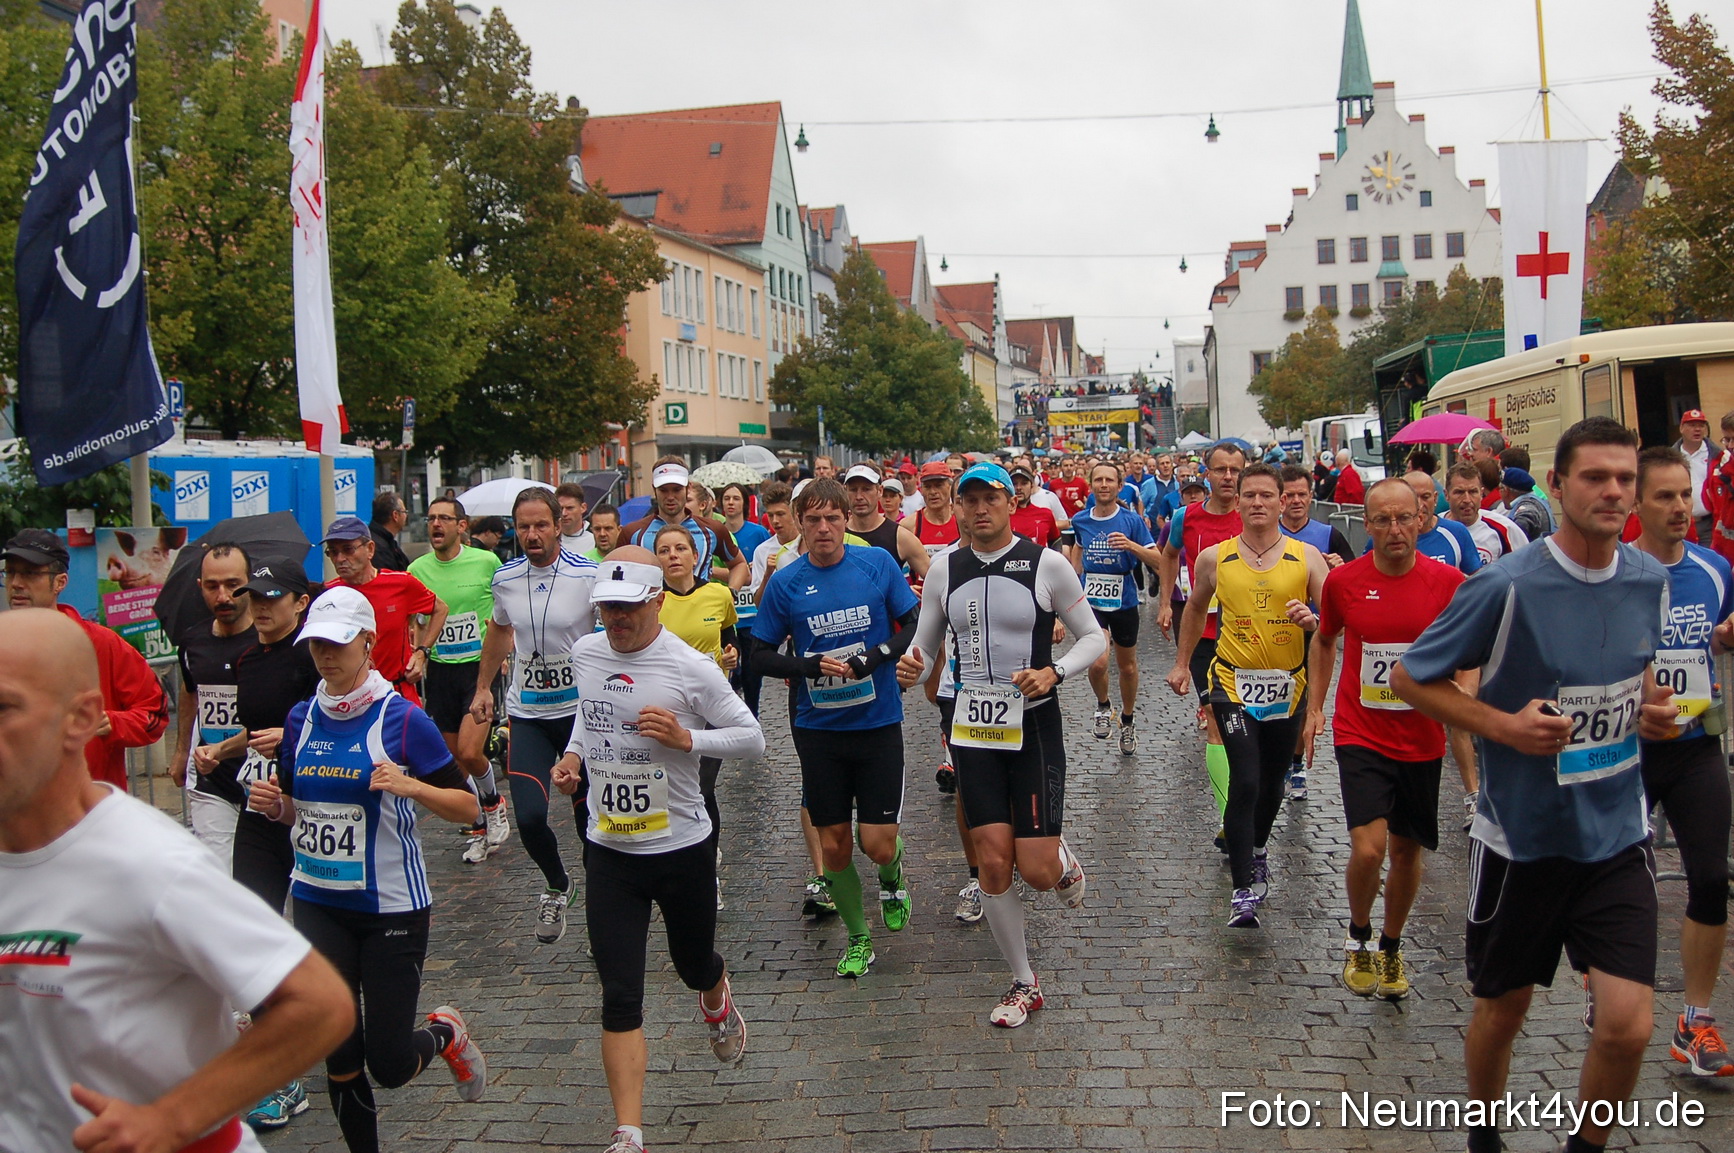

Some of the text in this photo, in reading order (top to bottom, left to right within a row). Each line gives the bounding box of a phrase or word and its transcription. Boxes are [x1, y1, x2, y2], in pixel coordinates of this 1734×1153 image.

[170, 386, 180, 413] P
[1506, 386, 1556, 415] Bayerisches
[668, 405, 685, 421] D
[1078, 414, 1109, 422] START
[1506, 416, 1530, 436] Rotes
[334, 473, 356, 491] IXI
[1087, 583, 1119, 597] 2256
[108, 602, 131, 614] BEIDE
[129, 607, 152, 619] GRÜN
[807, 605, 871, 629] HUBER
[439, 623, 476, 642] 2972
[823, 620, 868, 633] TECHNOLOGY
[968, 600, 981, 668] TSG 08 Roth
[1660, 621, 1713, 647] RNER
[1660, 657, 1696, 665] Neumarkt
[524, 666, 574, 689] 2988
[602, 684, 634, 694] skinfit
[822, 687, 861, 700] Christoph
[1241, 682, 1289, 704] 2254
[535, 694, 565, 703] Johann
[1560, 695, 1597, 706] PARTL
[968, 699, 1008, 724] 502
[1571, 698, 1635, 745] 2672
[969, 728, 1004, 740] Christof
[308, 740, 335, 751] HEITEC
[296, 765, 362, 780] LAC QUELLE
[591, 767, 651, 780] PARTL Neumarkt
[601, 783, 650, 813] 485
[310, 810, 349, 821] Neumarkt
[606, 818, 647, 832] Thomas
[297, 819, 356, 857] 2364
[306, 860, 339, 878] Simone
